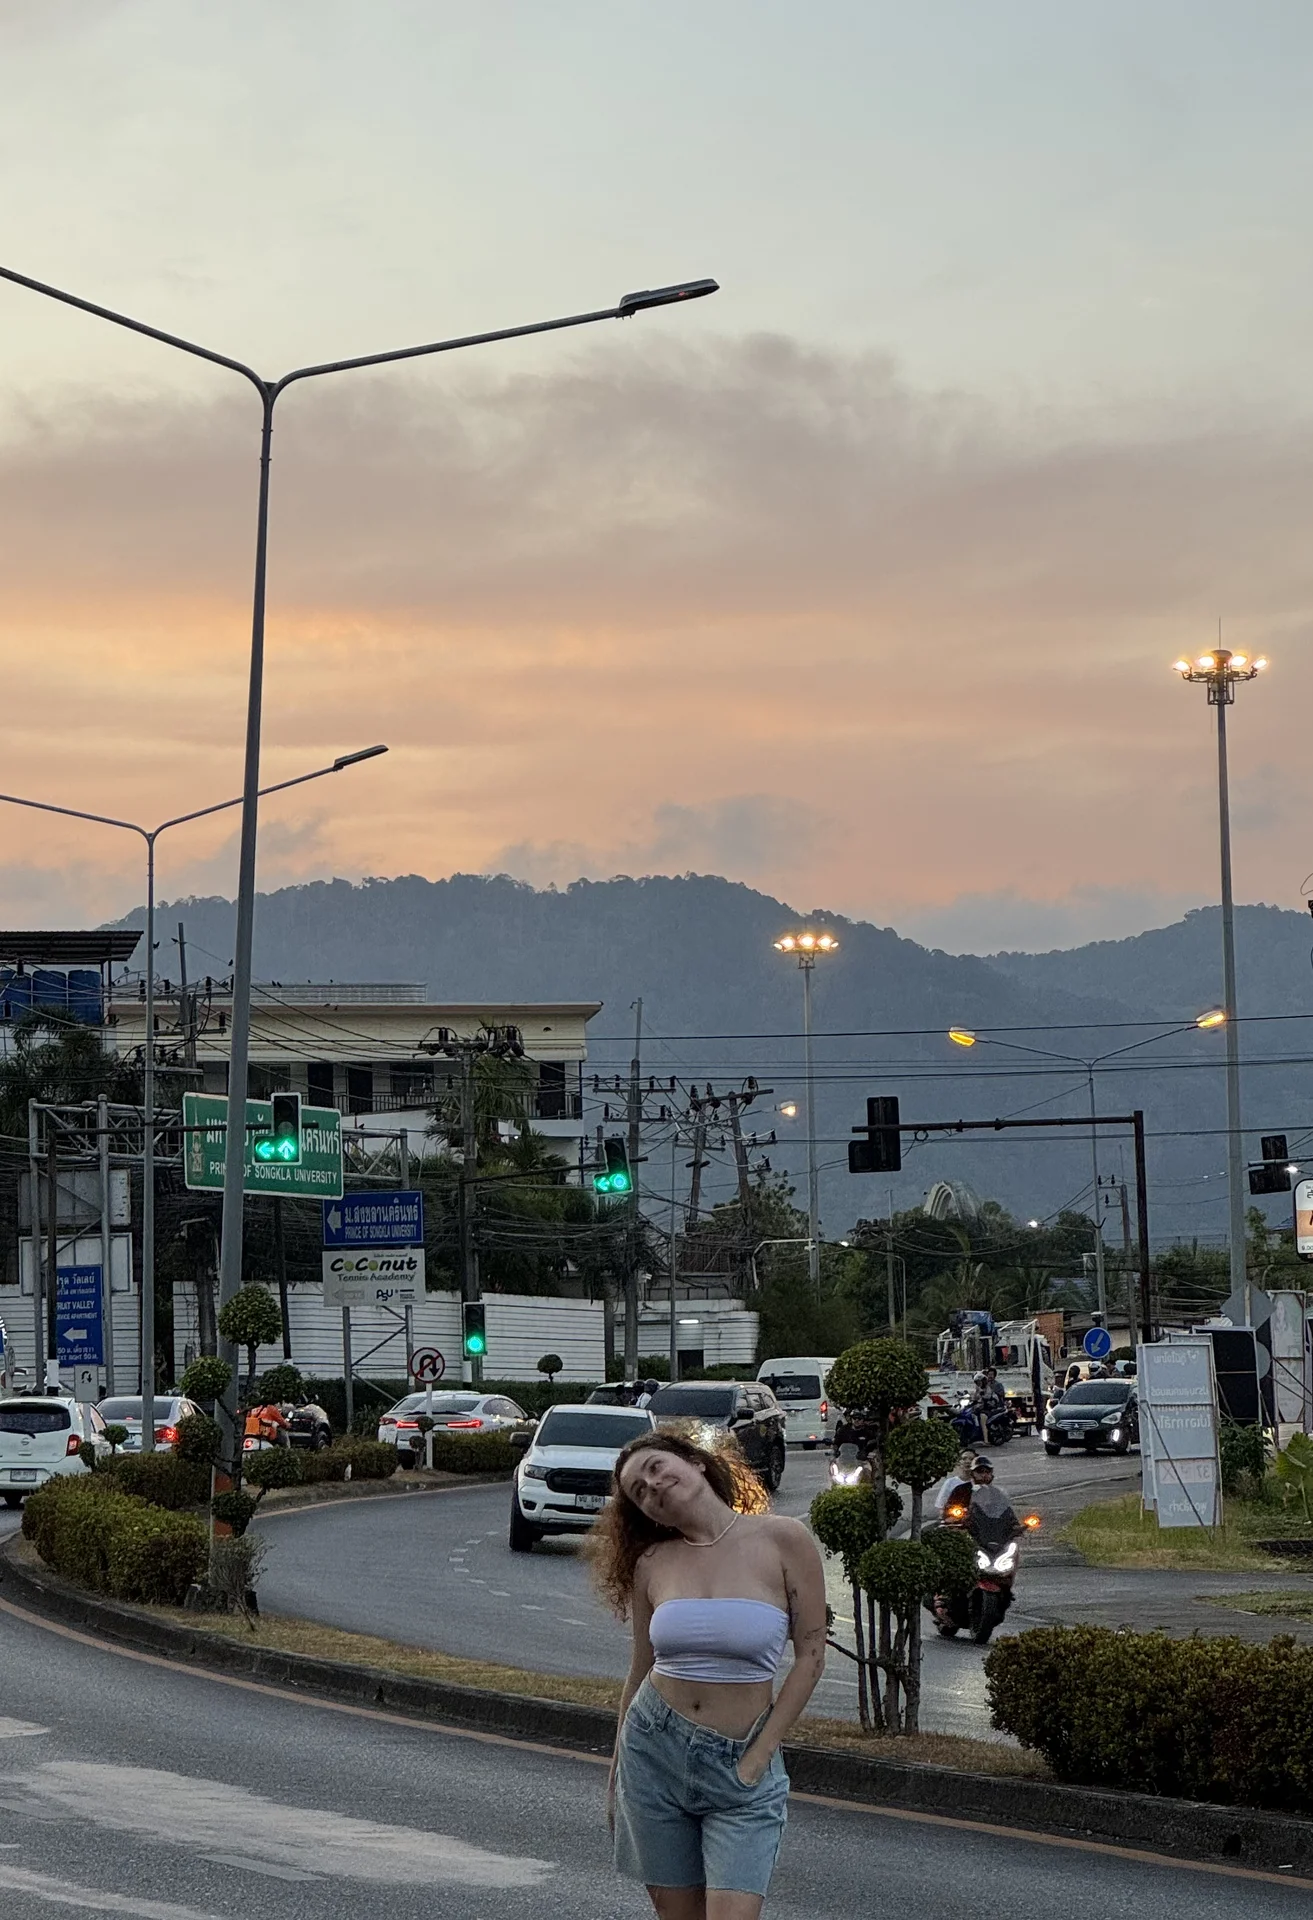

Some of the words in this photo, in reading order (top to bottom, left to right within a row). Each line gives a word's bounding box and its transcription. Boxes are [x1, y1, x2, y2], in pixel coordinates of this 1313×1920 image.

[209, 1161, 227, 1175] PRIN
[254, 1165, 292, 1180] SONGKLA
[294, 1168, 338, 1184] UNIVERSITY
[344, 1226, 362, 1239] PRINCE
[362, 1226, 369, 1238] OF
[369, 1225, 391, 1238] SONGKLA
[391, 1224, 417, 1238] UNIVERSITY
[337, 1273, 369, 1282] Tennis
[369, 1272, 416, 1282] Academy
[56, 1301, 71, 1311] RUIT
[72, 1300, 95, 1310] VALLEY
